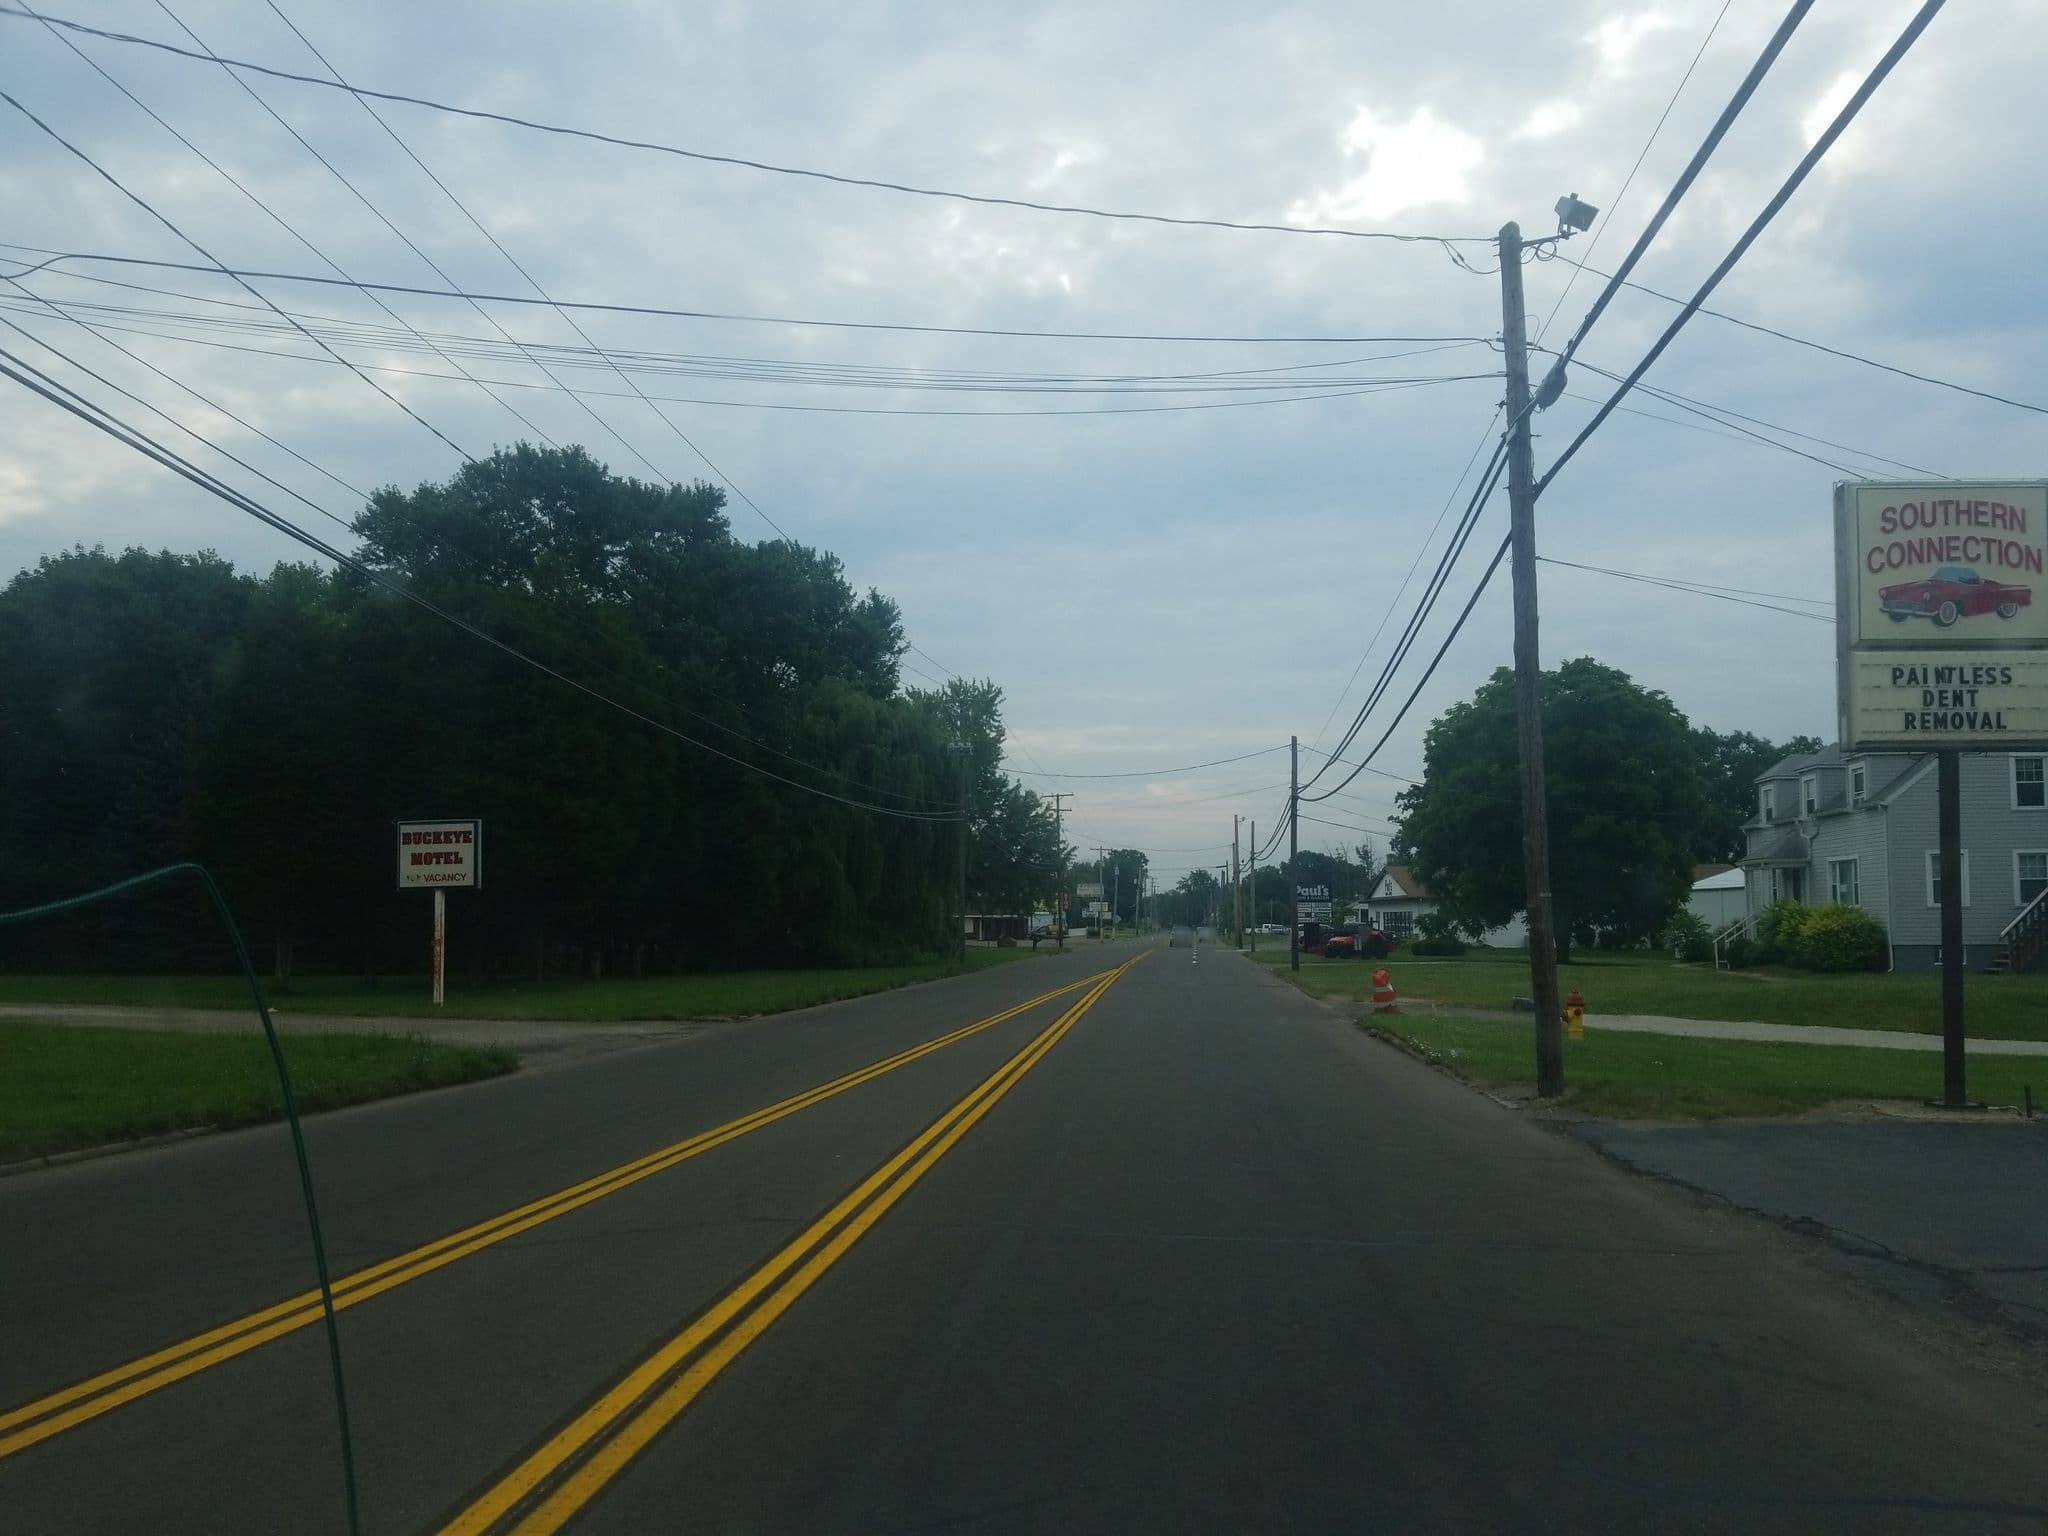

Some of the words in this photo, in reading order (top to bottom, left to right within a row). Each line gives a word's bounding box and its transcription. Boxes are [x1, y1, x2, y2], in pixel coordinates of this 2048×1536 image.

[1880, 499, 2027, 534] SOUTHERN
[1866, 535, 2043, 575] CONNECTION
[1892, 666, 2012, 686] PAINTLESS
[1922, 690, 1979, 708] DENT
[1904, 711, 2007, 730] REMOVAL
[402, 830, 473, 845] BUCKEYE
[411, 851, 463, 865] MOTEL
[423, 873, 467, 882] VACANCY
